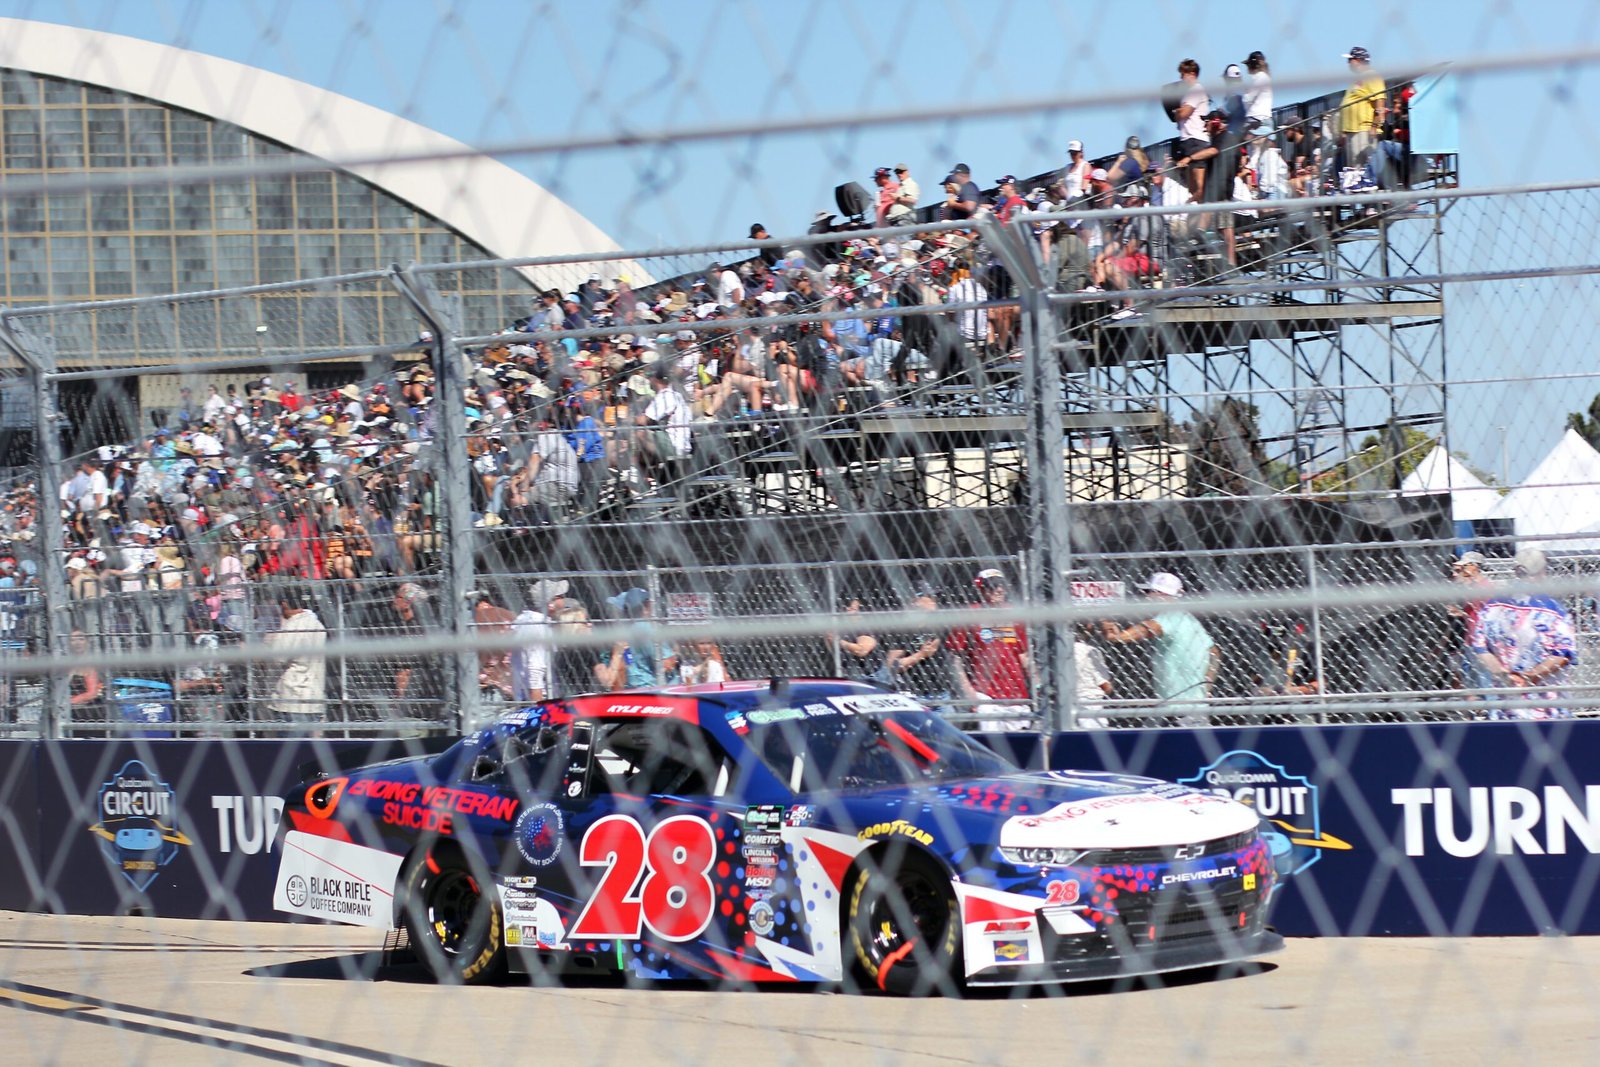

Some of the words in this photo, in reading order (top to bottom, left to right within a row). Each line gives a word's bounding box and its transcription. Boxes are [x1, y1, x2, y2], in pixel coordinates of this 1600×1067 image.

[607, 705, 641, 713] KYLE
[640, 706, 674, 714] SIEG
[1205, 771, 1277, 785] Qualcomm
[103, 791, 170, 815] CIRCUIT
[347, 779, 422, 803] ENDING
[421, 785, 519, 821] VETERAN
[382, 802, 453, 834] SUICIDE
[1391, 785, 1600, 858] TURN
[744, 835, 780, 844] COMETIC
[857, 819, 934, 846] GOODYEAR
[567, 814, 717, 942] 28
[745, 877, 772, 886] MSD
[1161, 866, 1237, 884] CHEVROLET
[310, 876, 342, 898] BLACK
[344, 881, 371, 901] RIFLE
[1044, 879, 1080, 905] 28
[310, 897, 336, 912] COFFEE
